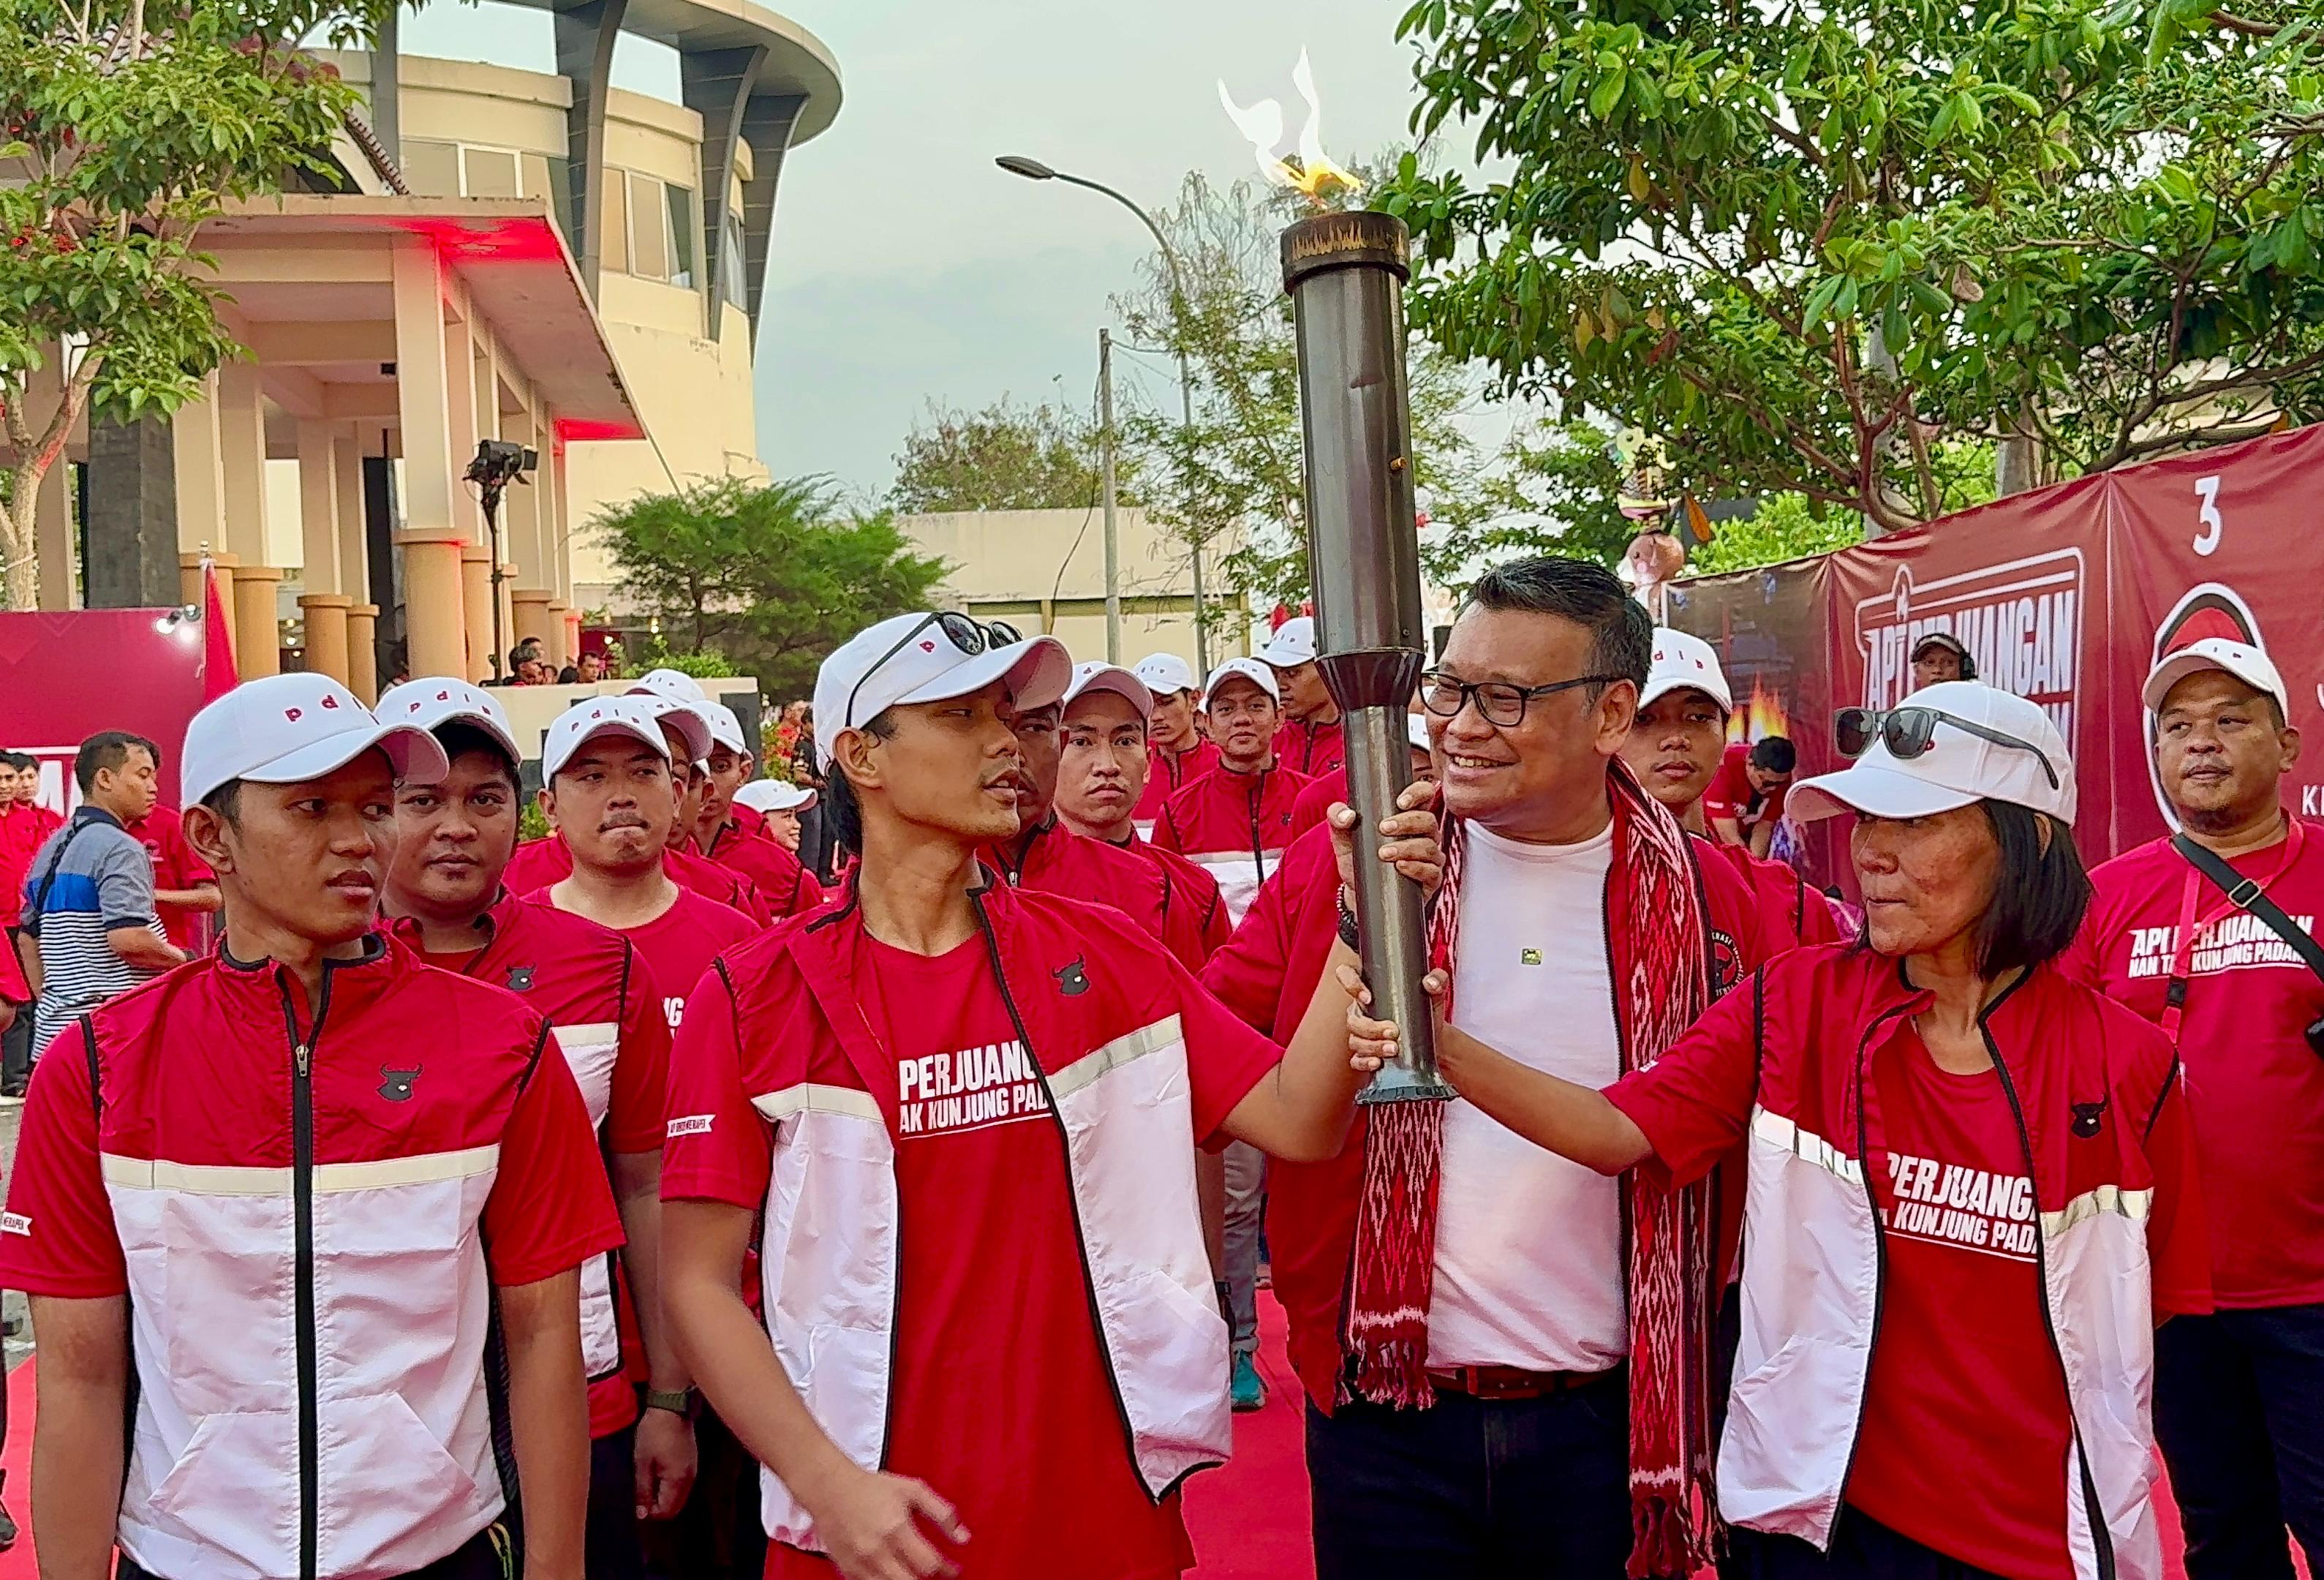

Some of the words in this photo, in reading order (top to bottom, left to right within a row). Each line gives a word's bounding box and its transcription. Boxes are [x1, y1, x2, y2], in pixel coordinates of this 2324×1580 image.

[2193, 474, 2221, 557] 3
[1907, 589, 2076, 696] PUANGAN
[2128, 926, 2171, 958] API
[2191, 943, 2253, 972] KUNJUNG
[927, 1087, 1009, 1130] KUNJUNG
[1893, 1200, 1989, 1246] KUNJUNG
[1991, 1220, 2038, 1254] PAD
